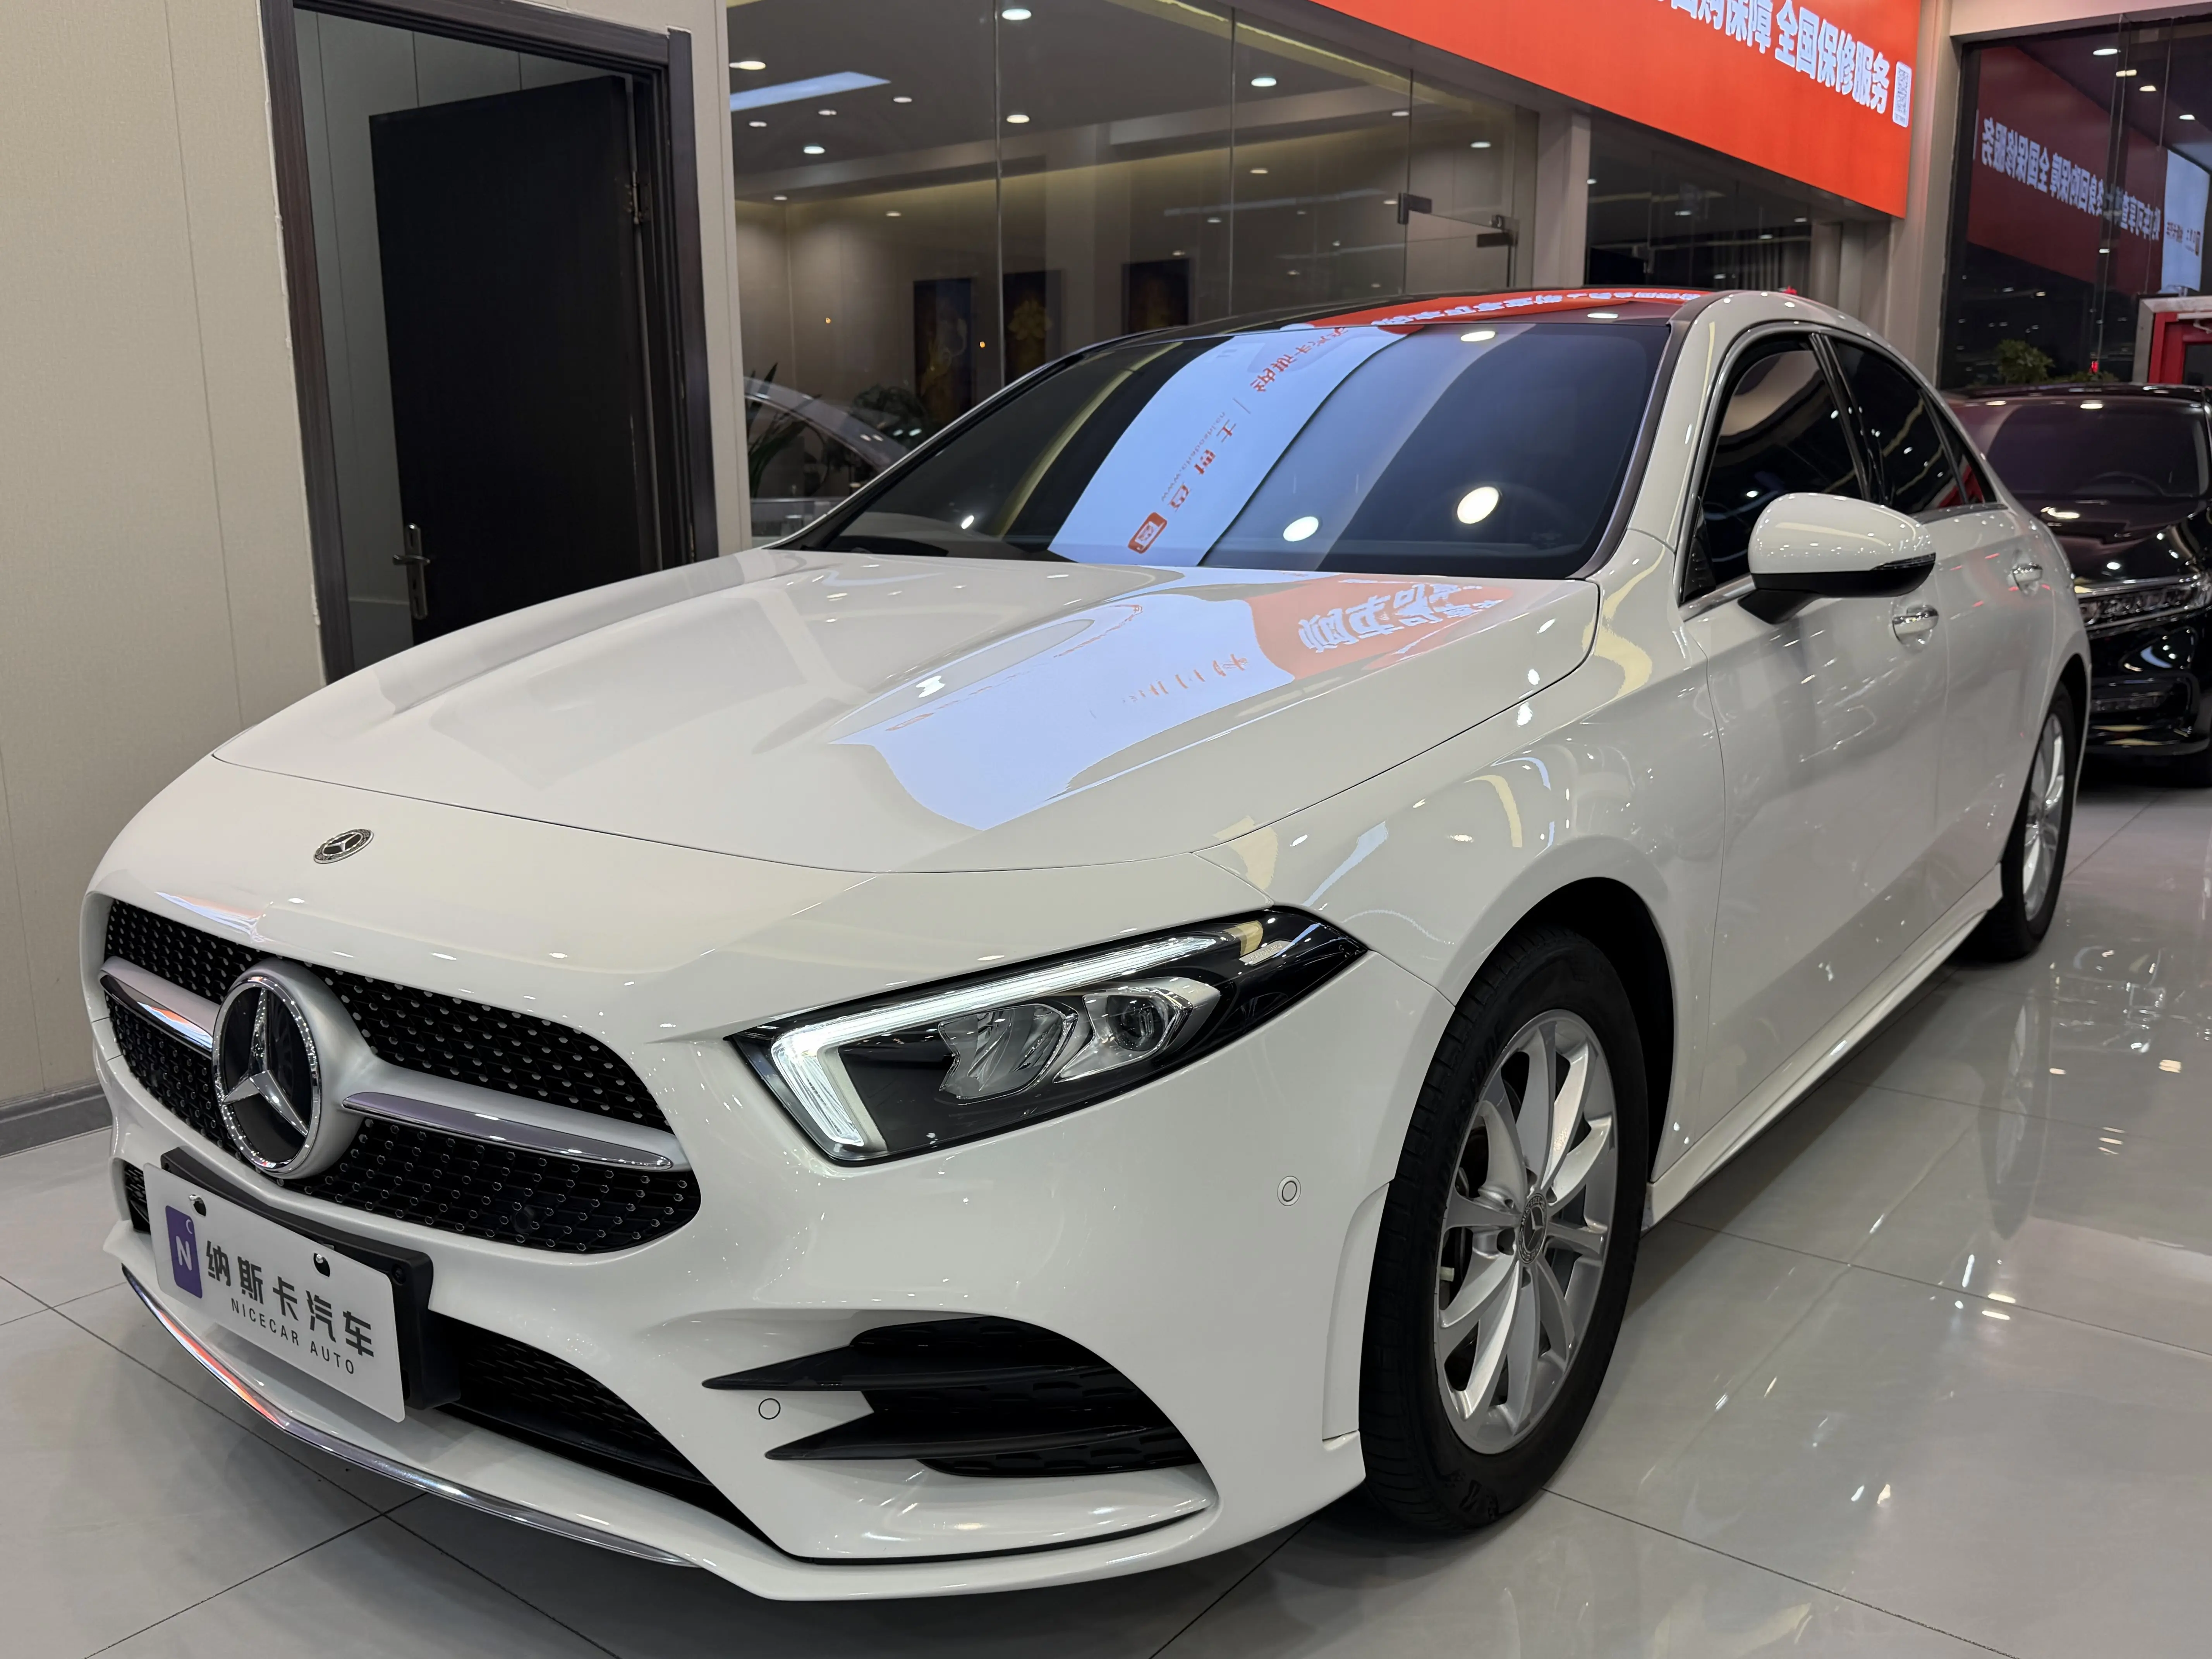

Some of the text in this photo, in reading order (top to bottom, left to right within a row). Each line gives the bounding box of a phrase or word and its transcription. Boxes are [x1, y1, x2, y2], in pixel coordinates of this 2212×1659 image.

[1775, 0, 1890, 114] 全国保修服务
[175, 1235, 192, 1271] N
[206, 1240, 374, 1358] 纳斯卡汽车
[231, 1298, 354, 1374] NICECAR AUTO
